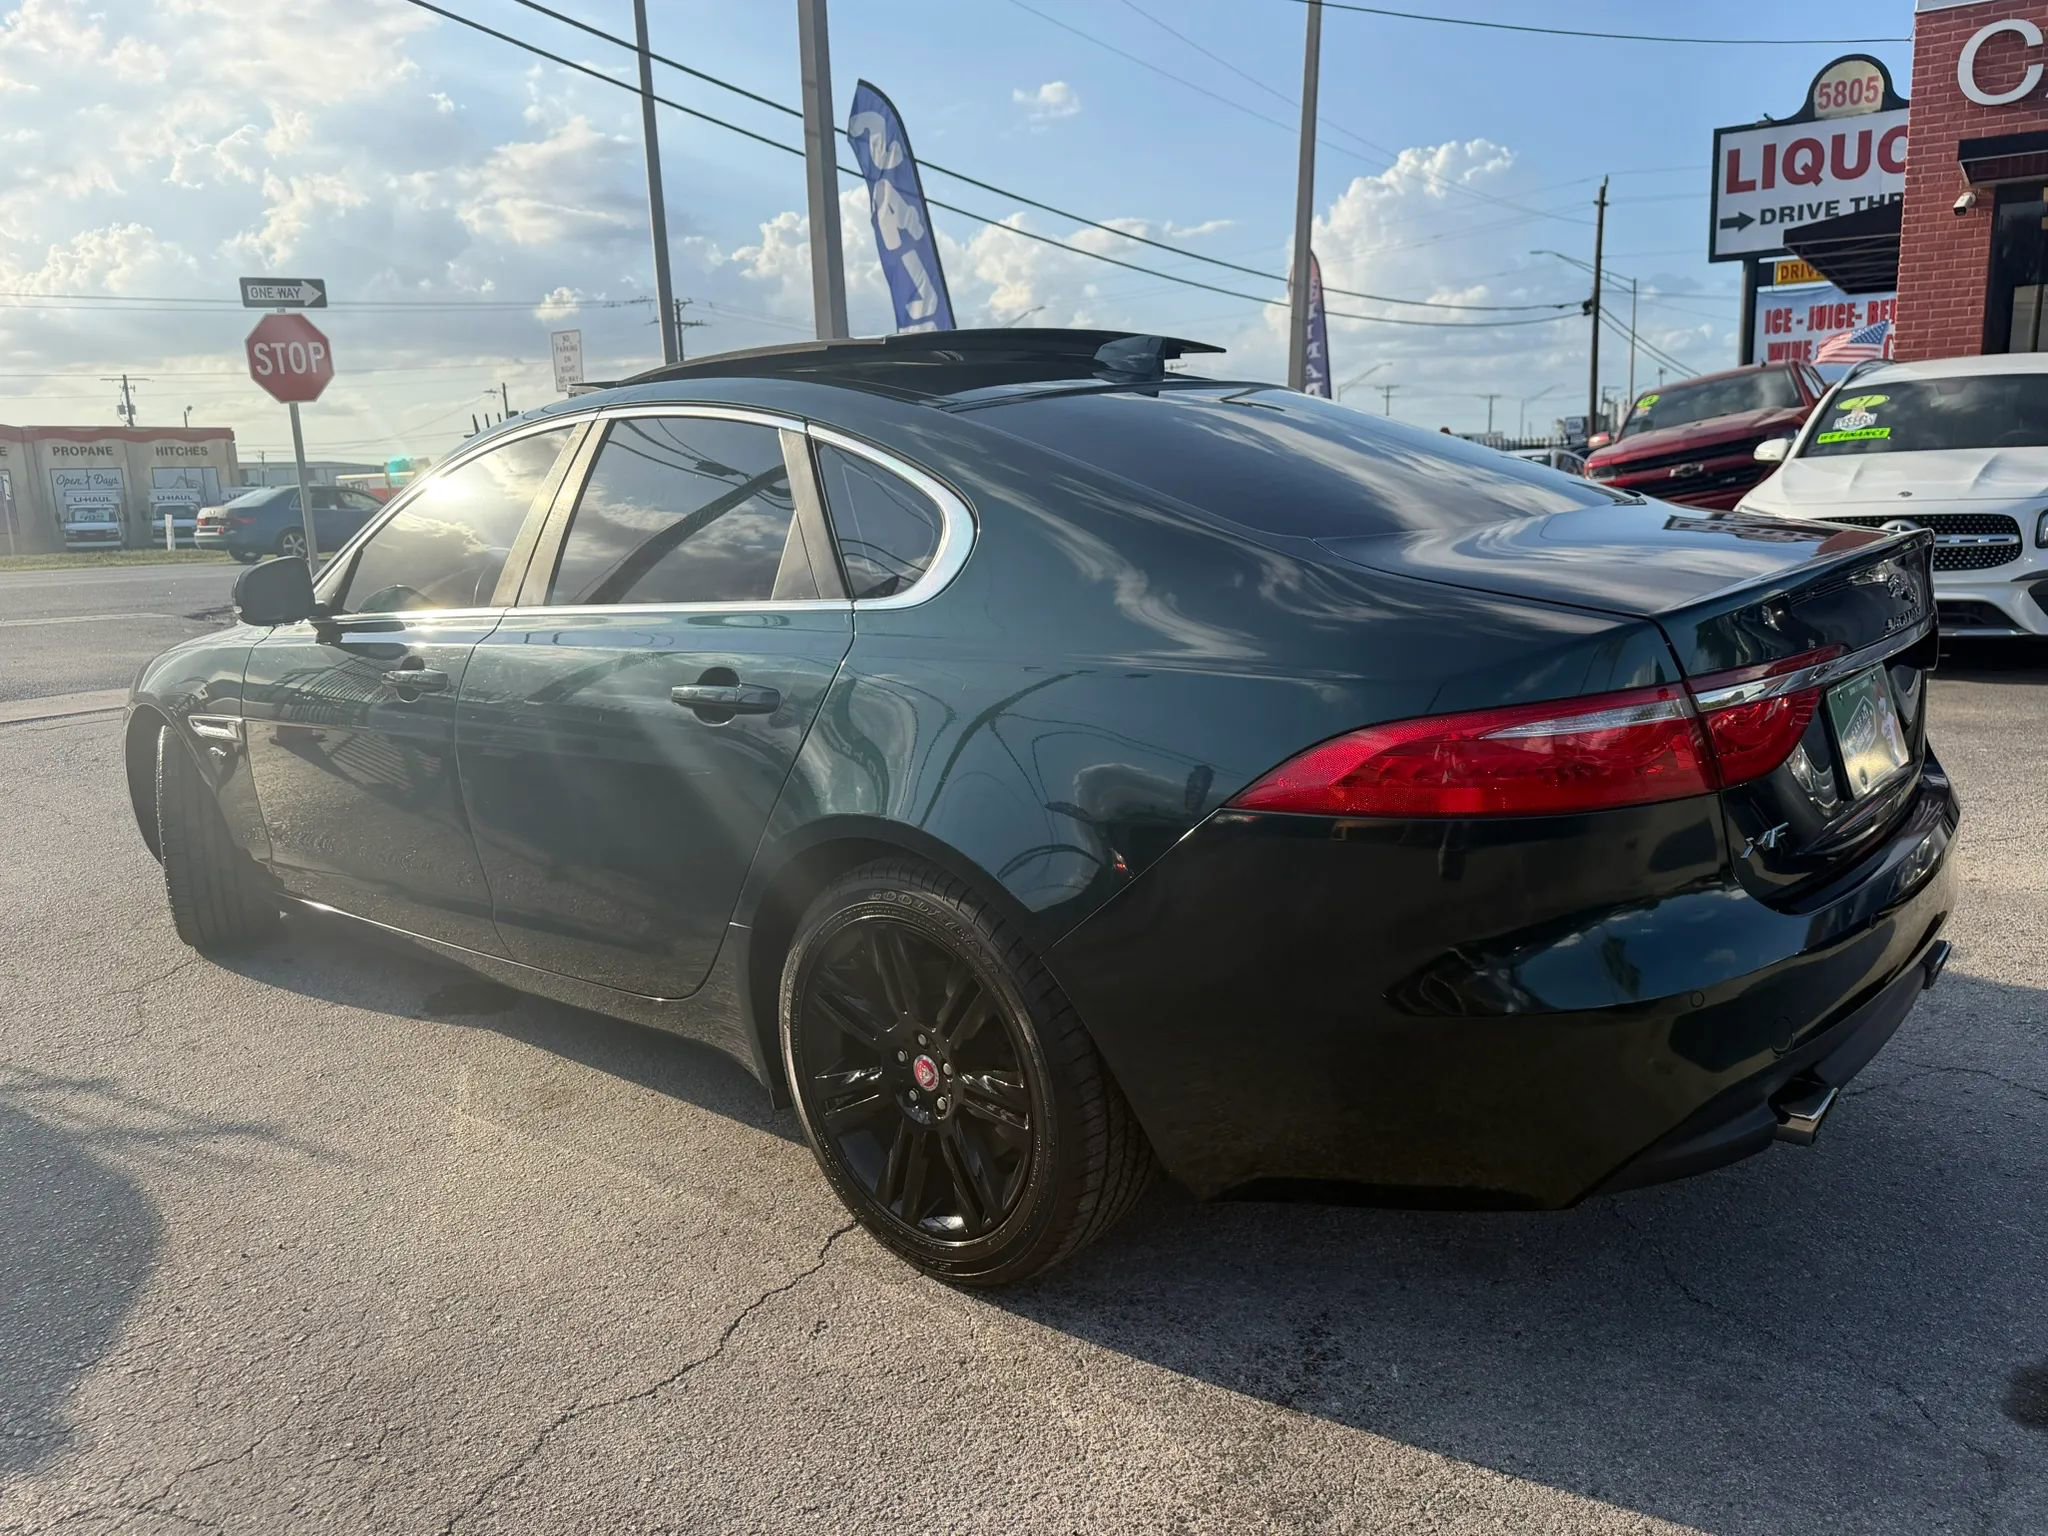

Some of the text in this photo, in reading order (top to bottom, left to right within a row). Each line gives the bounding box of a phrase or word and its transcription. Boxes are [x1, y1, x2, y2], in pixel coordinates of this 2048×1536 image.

[1957, 19, 2045, 105] C
[1817, 76, 1879, 110] 5805
[1759, 200, 1840, 226] DRIVE
[1780, 261, 1822, 281] DRIV
[250, 287, 301, 299] ONE WAY
[1764, 308, 1793, 335] ICE
[253, 341, 325, 376] STOP
[1767, 340, 1812, 363] WINE
[52, 446, 114, 456] PROPANE
[155, 446, 208, 456] HITCHES
[93, 473, 119, 487] Days
